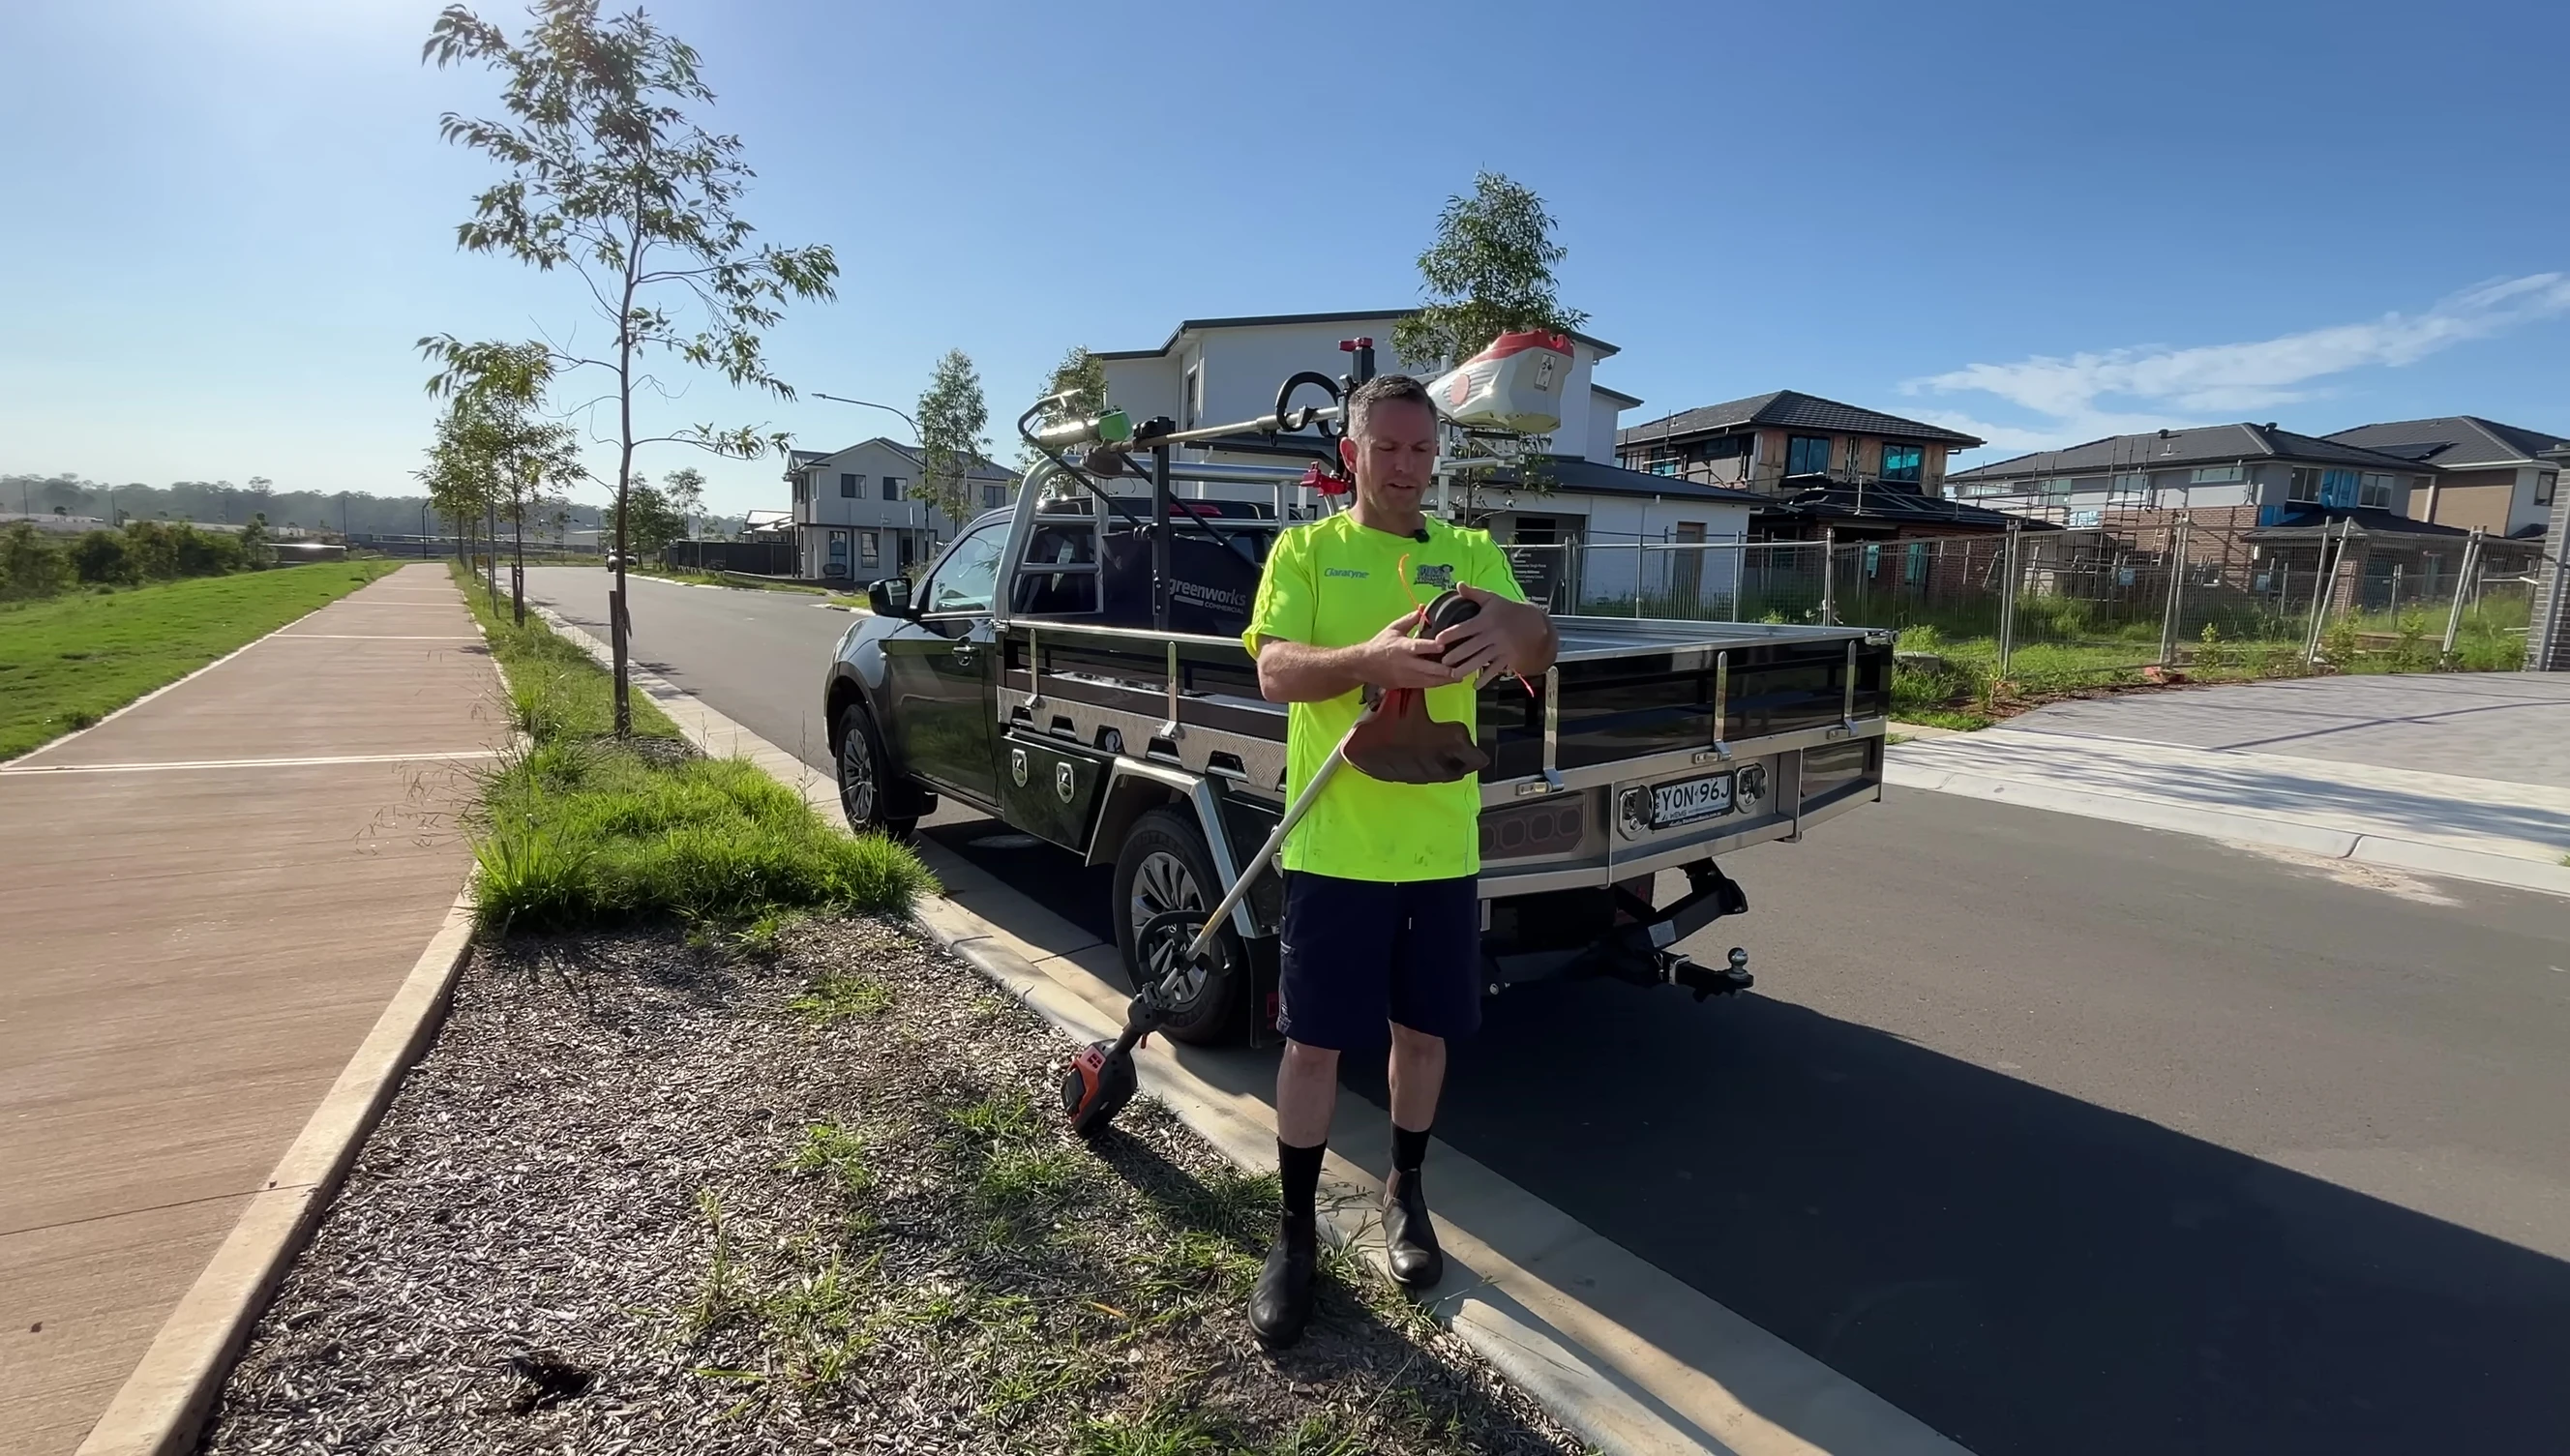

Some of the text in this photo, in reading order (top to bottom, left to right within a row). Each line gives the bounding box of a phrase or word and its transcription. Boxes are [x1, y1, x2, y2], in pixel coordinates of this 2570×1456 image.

[1324, 567, 1370, 579] Claratyne
[1169, 579, 1246, 607] greenworks
[1204, 601, 1245, 615] COMMERCIAL
